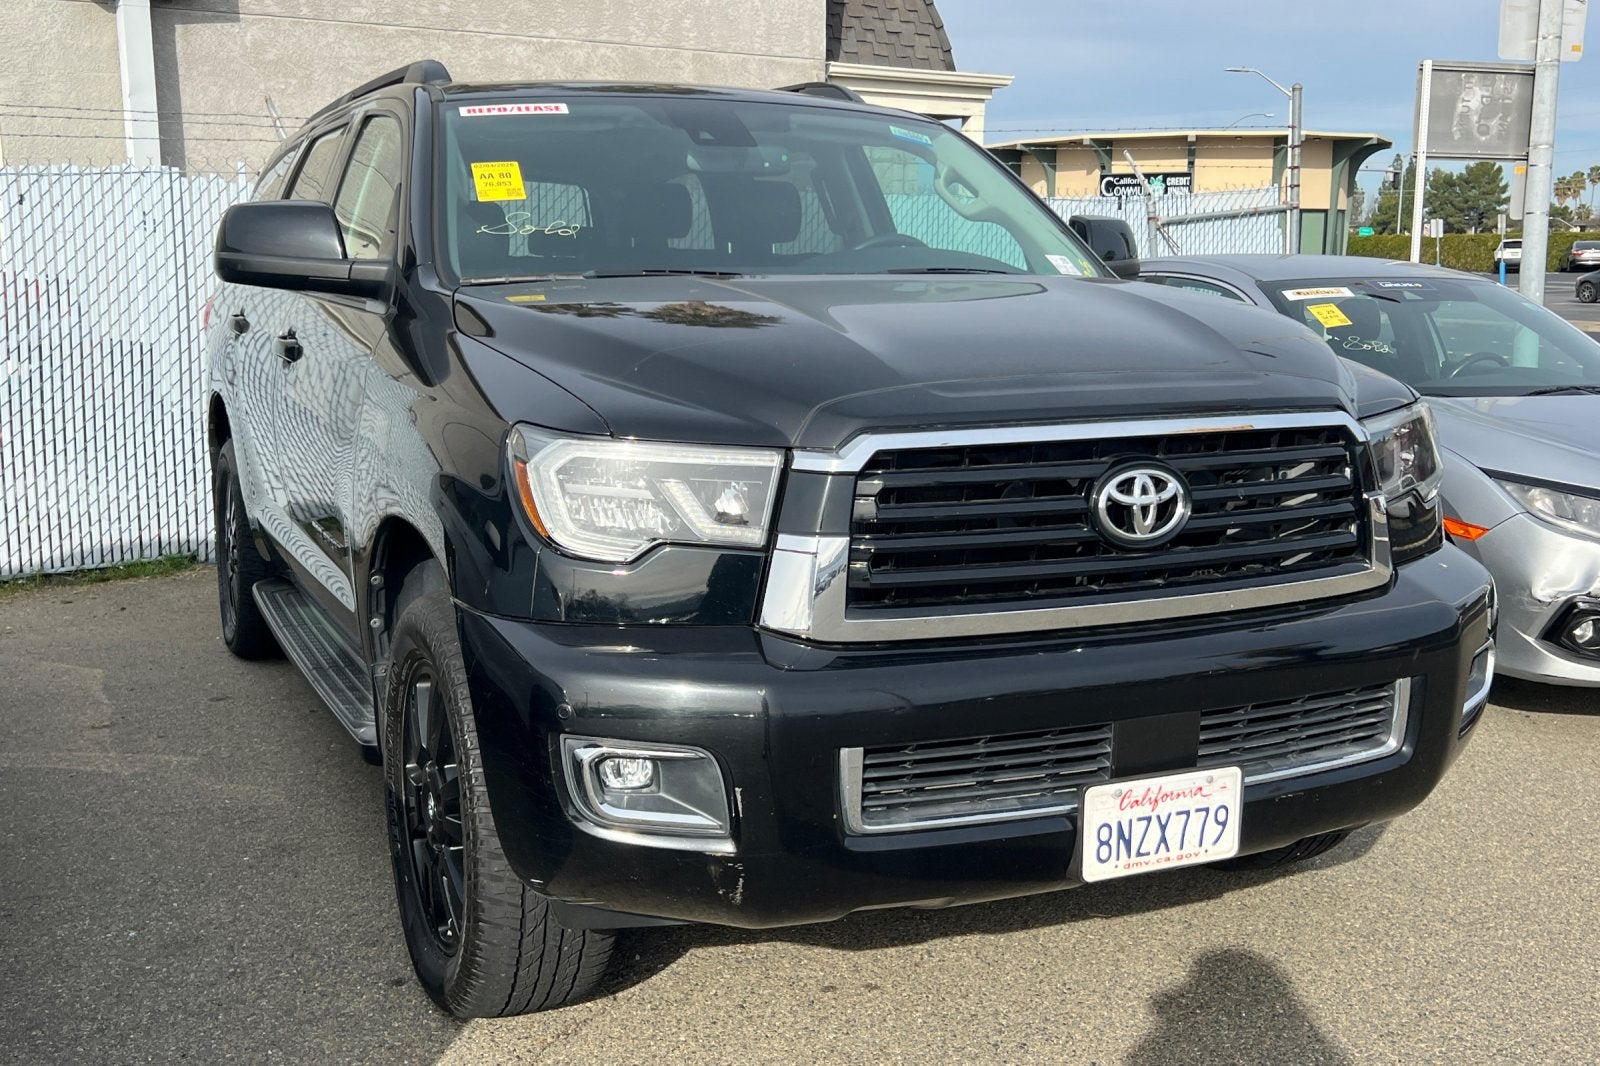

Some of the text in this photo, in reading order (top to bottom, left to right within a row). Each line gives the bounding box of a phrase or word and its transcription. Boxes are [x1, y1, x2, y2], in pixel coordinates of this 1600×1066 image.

[466, 105, 562, 114] REPO/LEASE
[480, 172, 495, 180] AA
[1166, 177, 1191, 186] CREDIT
[1119, 785, 1212, 812] California
[1096, 804, 1229, 864] 8NZX779
[1123, 851, 1201, 870] dmv.ca.gov
